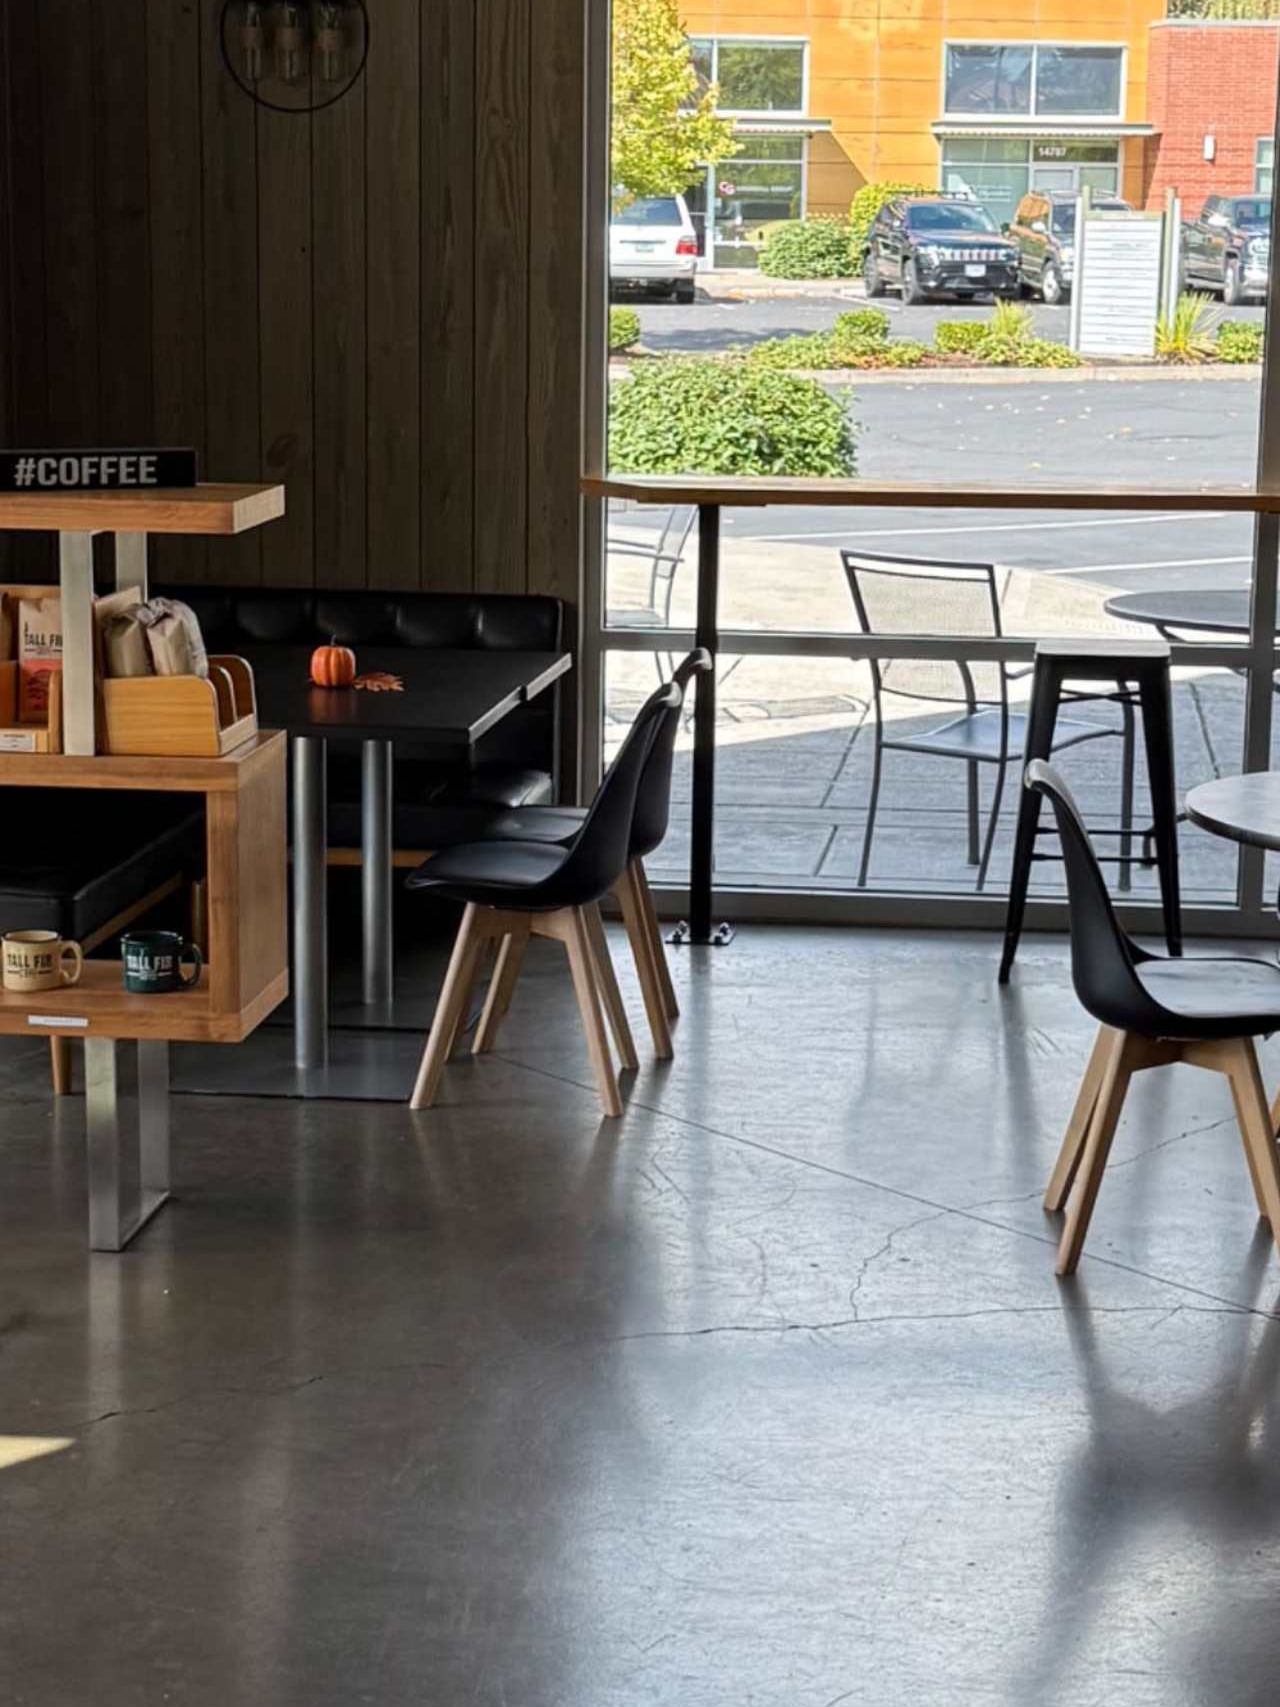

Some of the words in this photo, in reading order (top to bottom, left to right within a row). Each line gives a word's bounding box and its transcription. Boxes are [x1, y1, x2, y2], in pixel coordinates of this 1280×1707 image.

[14, 455, 158, 486] #COFFEE
[24, 634, 45, 646] TALL
[7, 953, 30, 968] TALL
[33, 954, 53, 968] FIR
[126, 955, 150, 969] TALL
